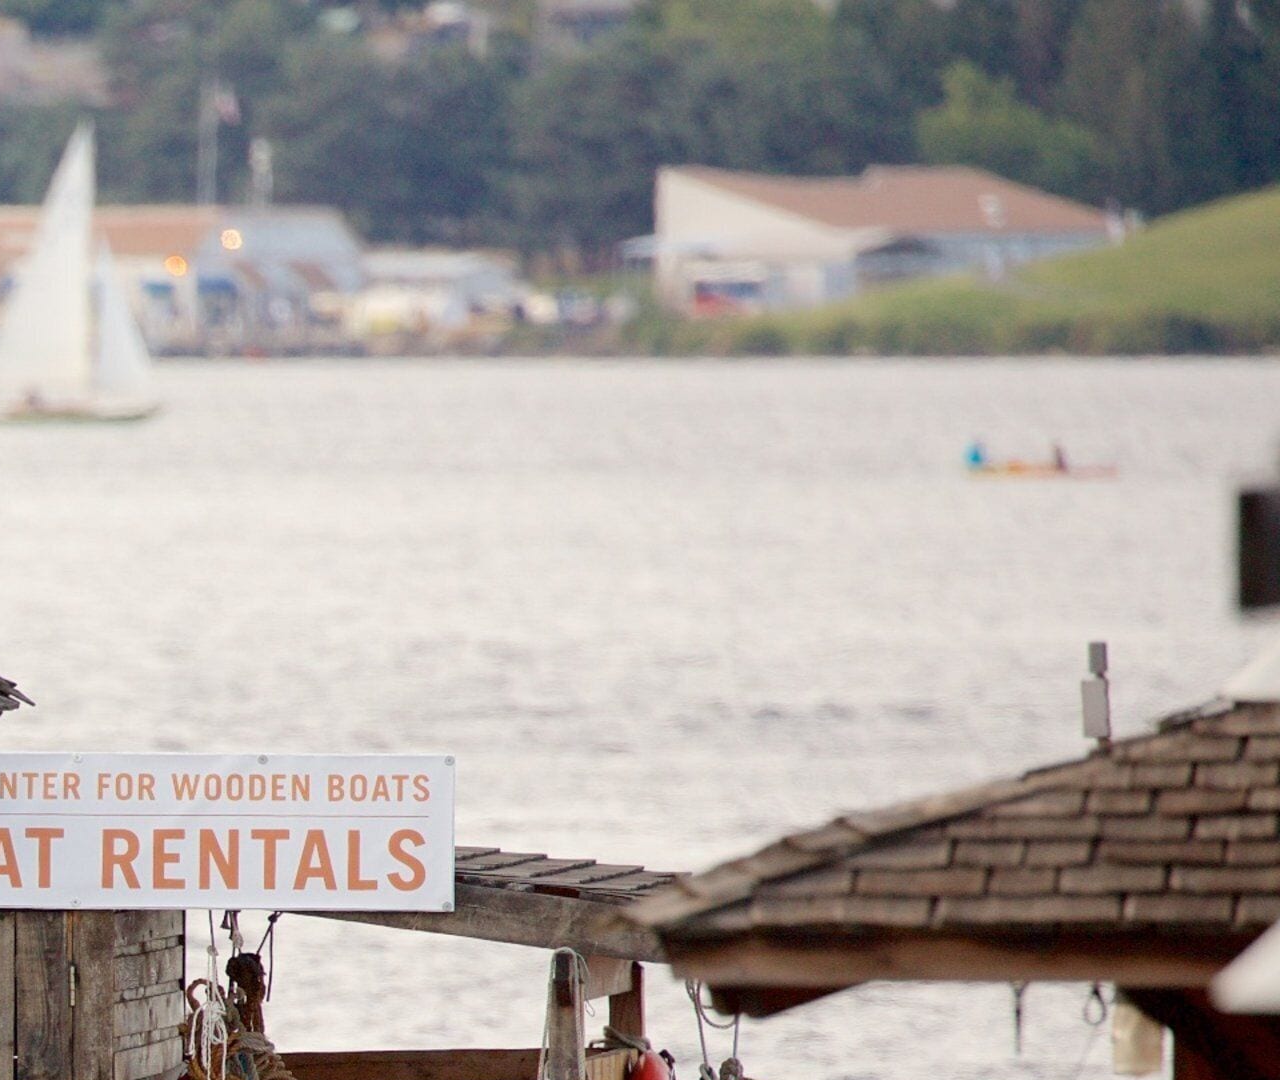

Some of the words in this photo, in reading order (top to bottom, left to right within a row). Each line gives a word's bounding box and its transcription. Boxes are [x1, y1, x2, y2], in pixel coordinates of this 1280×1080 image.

[96, 772, 157, 802] FOR
[170, 772, 312, 803] WOODEN
[327, 773, 430, 803] BOATS
[101, 826, 428, 892] RENTALS
